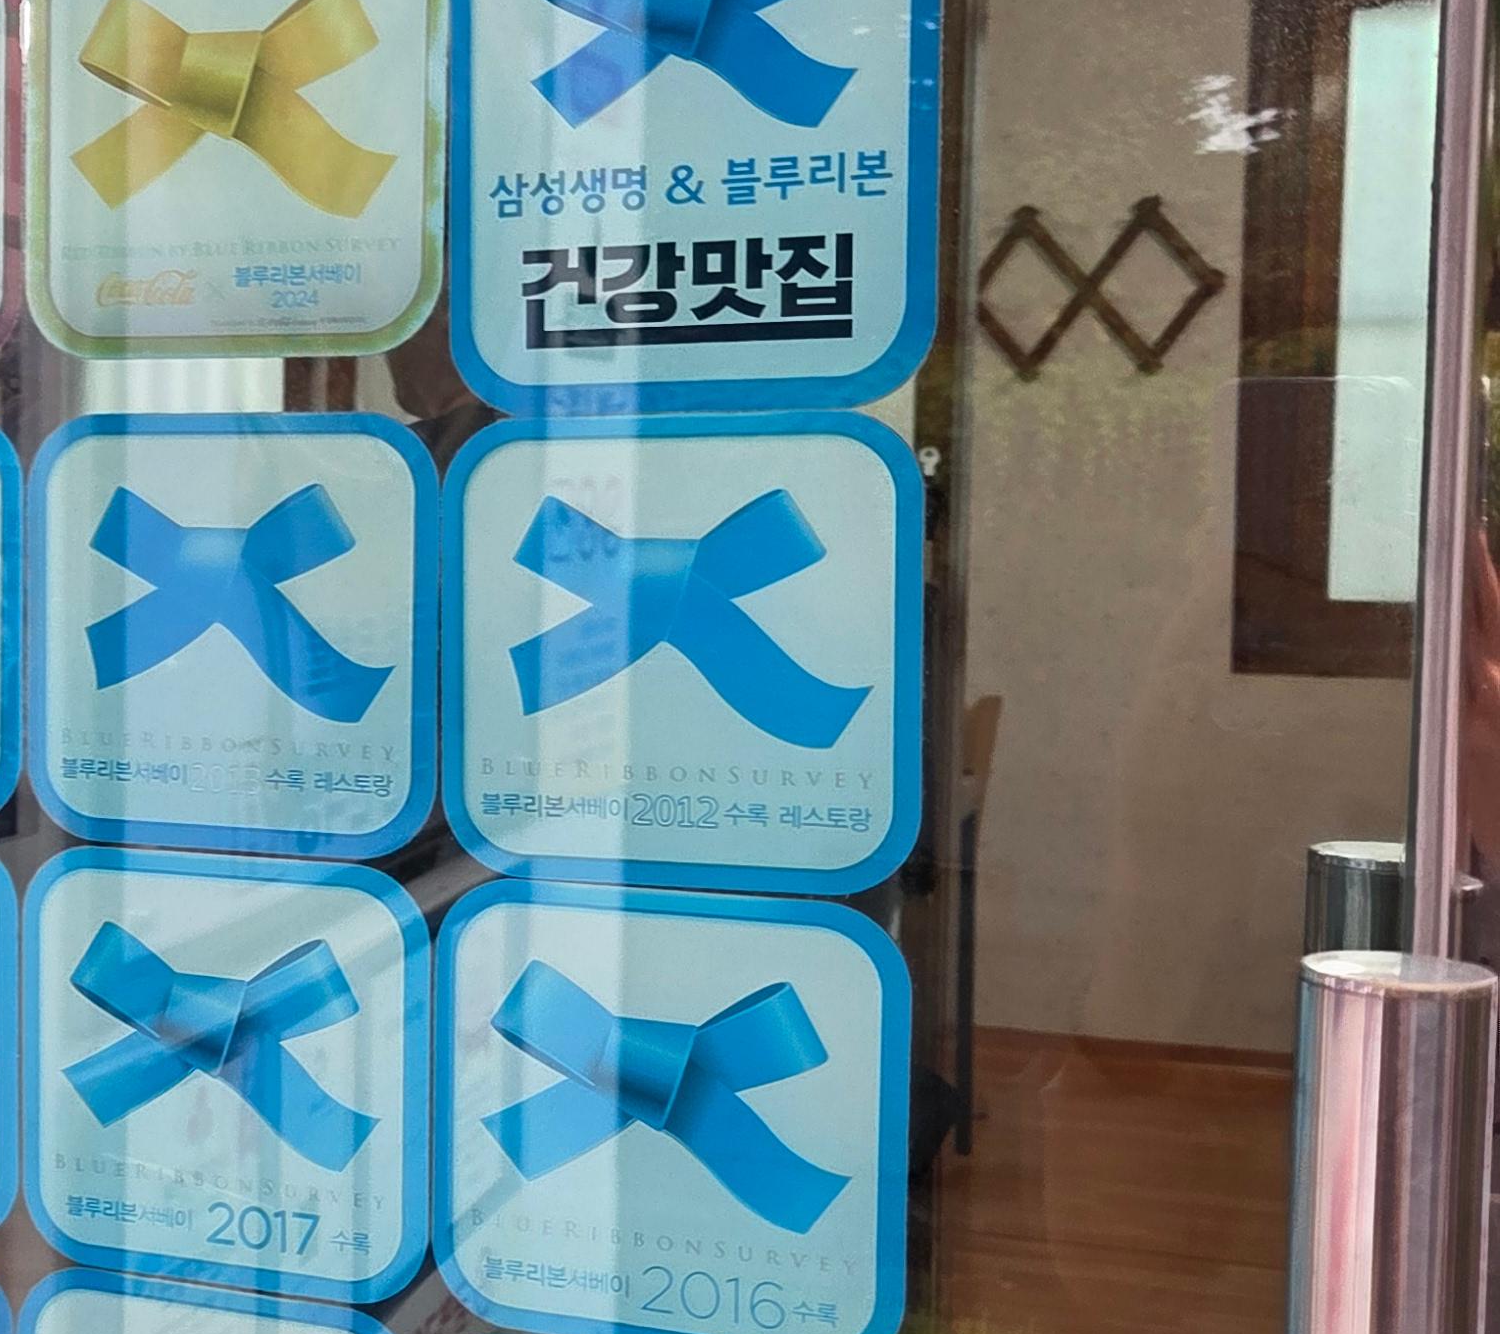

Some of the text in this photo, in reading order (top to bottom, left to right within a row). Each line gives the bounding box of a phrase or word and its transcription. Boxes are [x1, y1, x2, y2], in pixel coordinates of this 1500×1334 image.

[489, 150, 893, 218] 삼성생명 & 블루리본
[231, 264, 363, 289] 블루리본서베이
[271, 290, 320, 309] 2024
[521, 233, 853, 350] 건강맛집
[60, 756, 187, 787] 블루리본서베이
[263, 768, 306, 793] 수록
[313, 770, 394, 798] 레스토랑
[479, 792, 873, 833] 블루리본서베이 2012 수록 레스토랑
[64, 1194, 372, 1256] 블루리본서베이 2017 수록
[483, 1255, 841, 1330] 블루리본서베이 2016 수록
